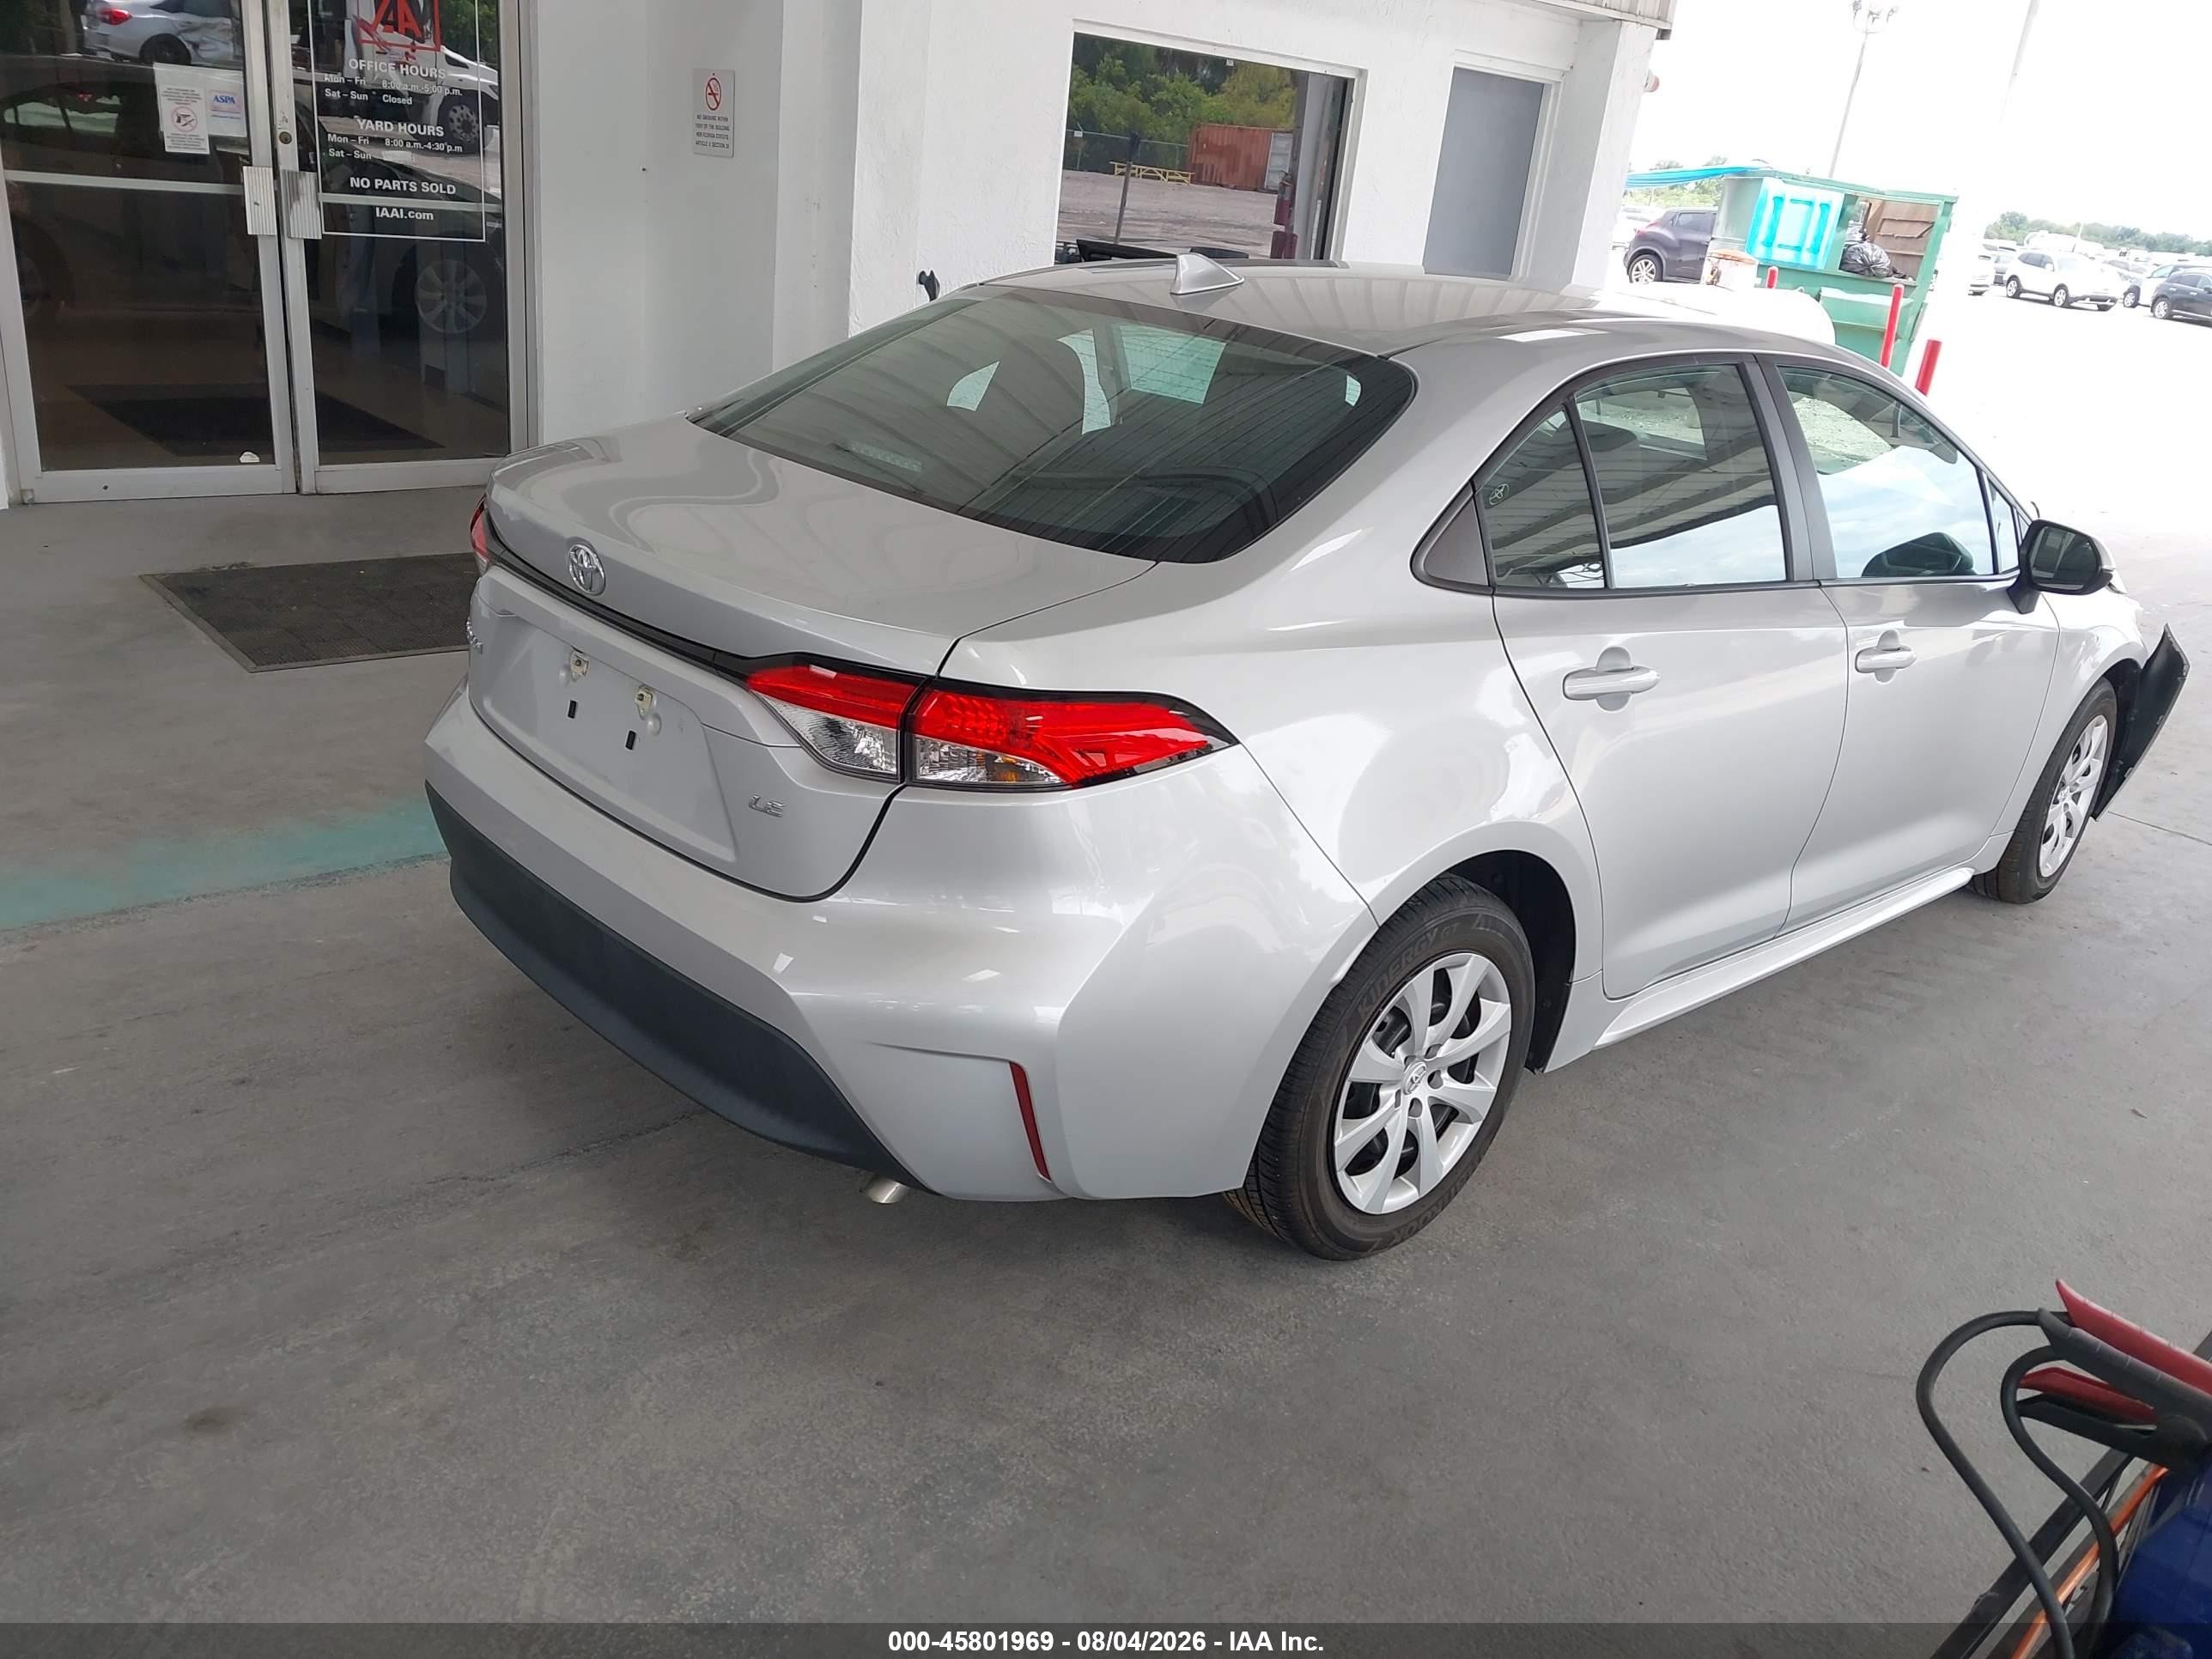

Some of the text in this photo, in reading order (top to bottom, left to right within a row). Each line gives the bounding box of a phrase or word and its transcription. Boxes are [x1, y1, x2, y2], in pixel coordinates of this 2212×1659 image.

[349, 58, 447, 79] OFFICE HOURS
[324, 74, 345, 83] Mon
[355, 76, 366, 85] Fri
[444, 88, 463, 96] p.m.
[325, 88, 341, 98] Sat
[349, 90, 368, 100] Sun
[382, 94, 412, 105] Closed
[357, 118, 445, 137] YARD HOURS
[327, 134, 349, 143] Mon
[358, 136, 369, 145] Fri
[385, 137, 404, 148] 8:00
[328, 148, 344, 157] Sat
[354, 150, 372, 160] Sun
[349, 176, 456, 195] NO PARTS SOLD
[375, 206, 434, 221] IAAI.com
[749, 795, 784, 817] LE
